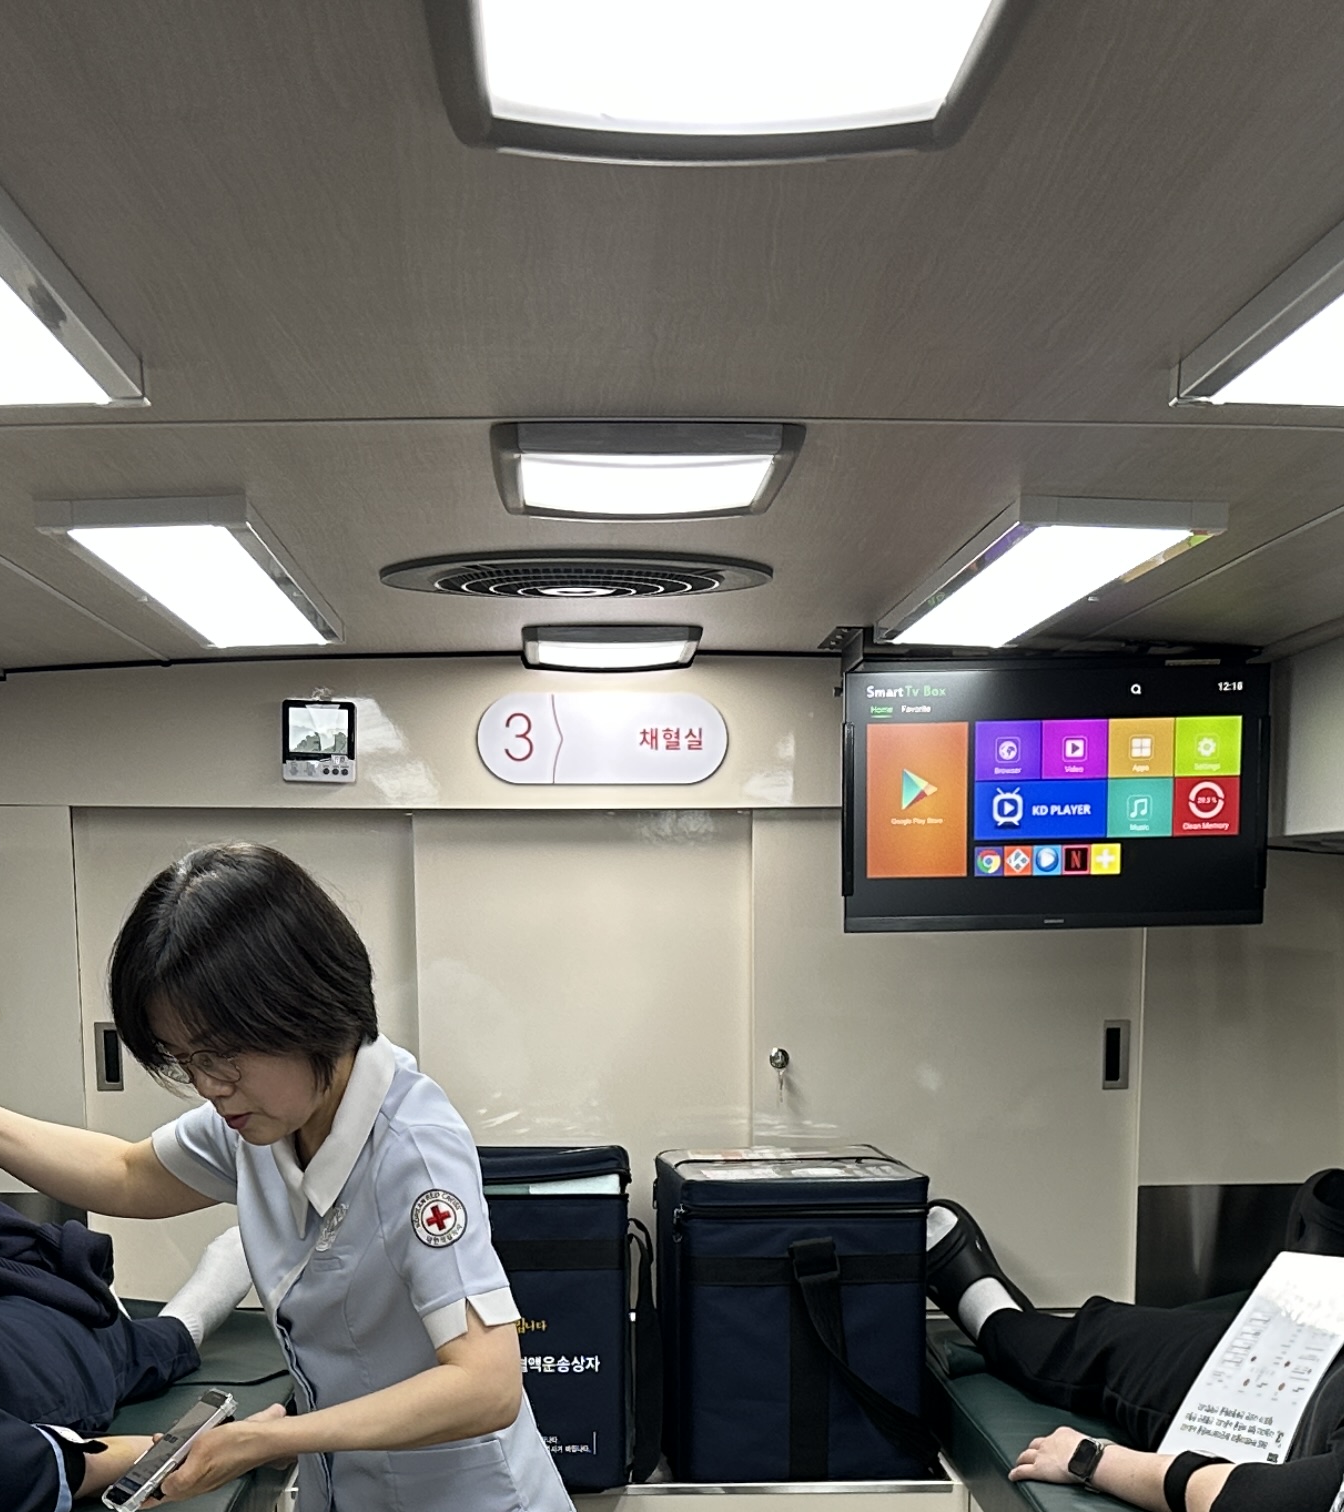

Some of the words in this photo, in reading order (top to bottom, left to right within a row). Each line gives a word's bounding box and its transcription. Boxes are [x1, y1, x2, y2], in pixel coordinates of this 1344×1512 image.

[866, 685, 904, 698] Smart
[923, 685, 946, 697] Box
[901, 705, 932, 713] Favorite
[504, 712, 534, 762] 3
[639, 727, 703, 751] 채혈실
[1064, 765, 1084, 773] Video
[1132, 764, 1149, 772] Apps
[1032, 805, 1049, 816] KD
[1050, 804, 1091, 815] PLAYER
[1130, 823, 1149, 831] Music
[1070, 850, 1081, 869] N
